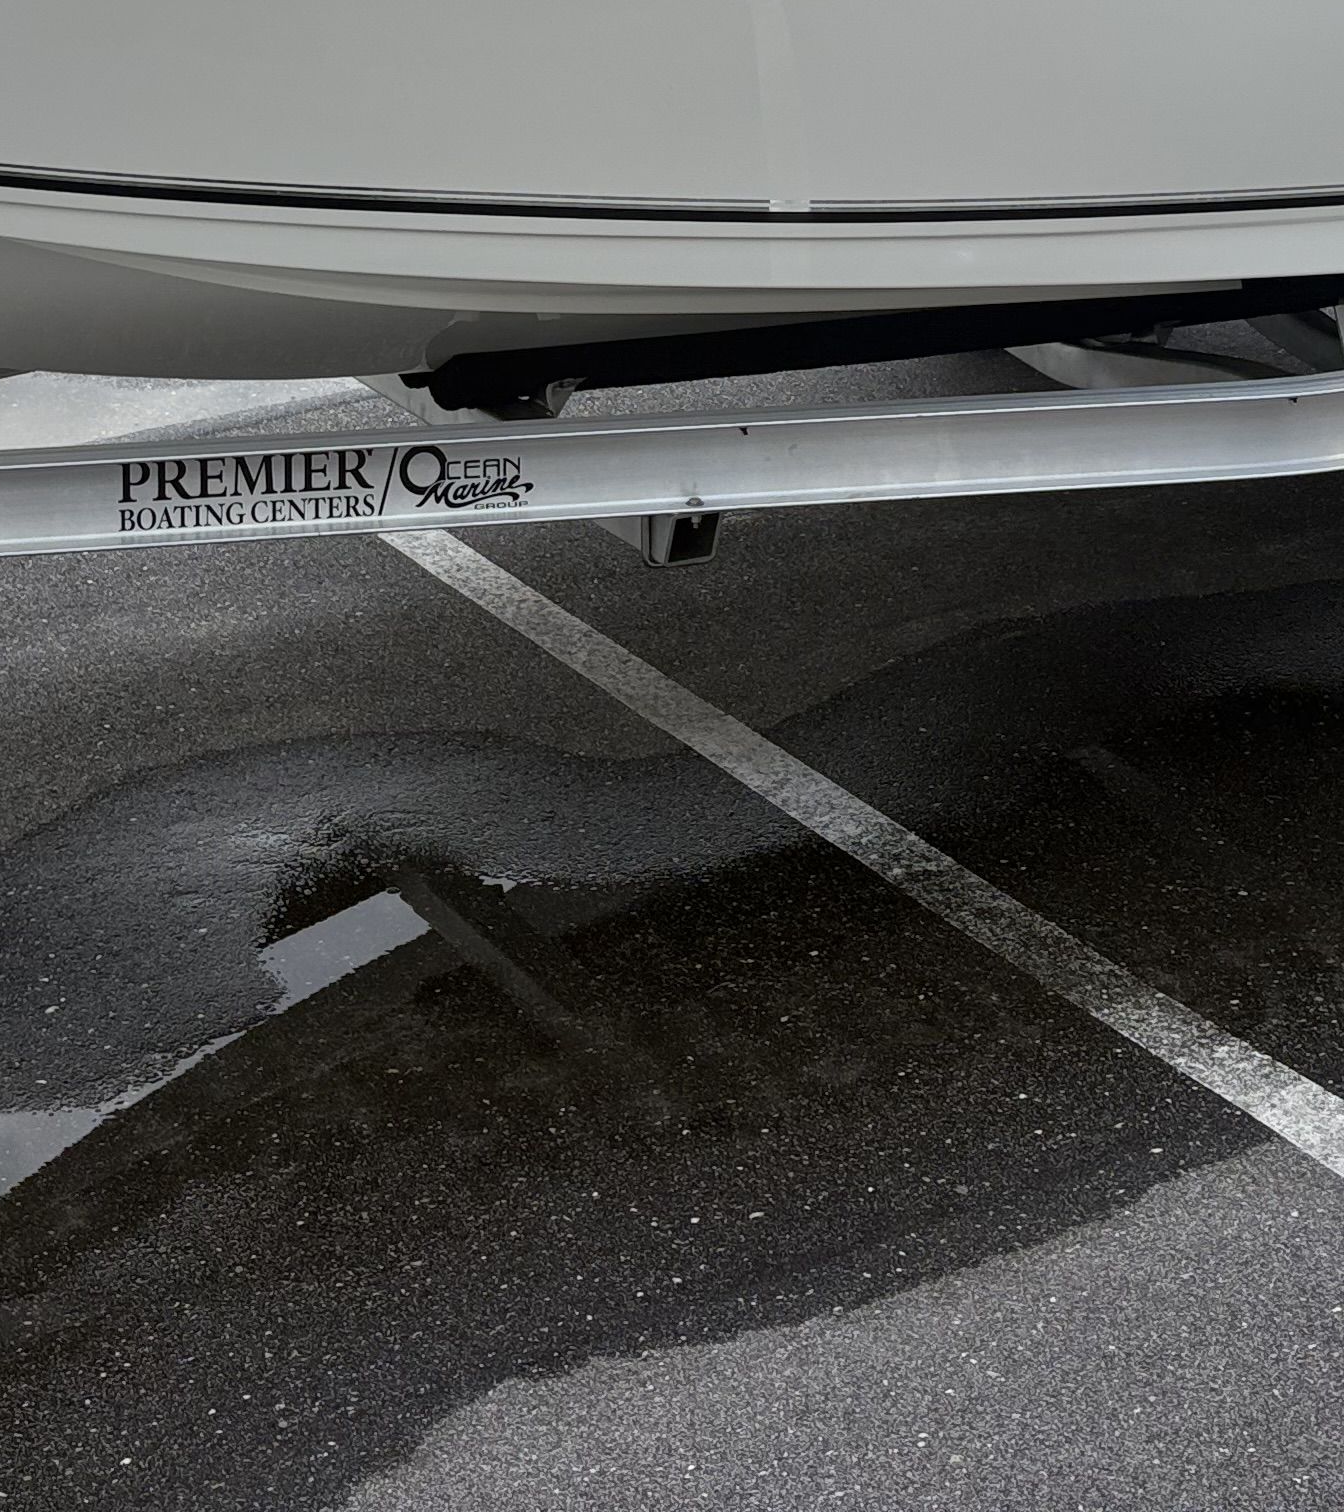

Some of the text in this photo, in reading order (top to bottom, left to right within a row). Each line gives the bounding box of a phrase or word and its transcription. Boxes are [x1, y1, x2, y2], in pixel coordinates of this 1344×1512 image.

[118, 448, 375, 503] PREMIER
[399, 445, 521, 495] OCEAN
[415, 475, 534, 508] Marine
[474, 500, 528, 510] GROUP
[118, 493, 375, 532] BOATING CENTERS
